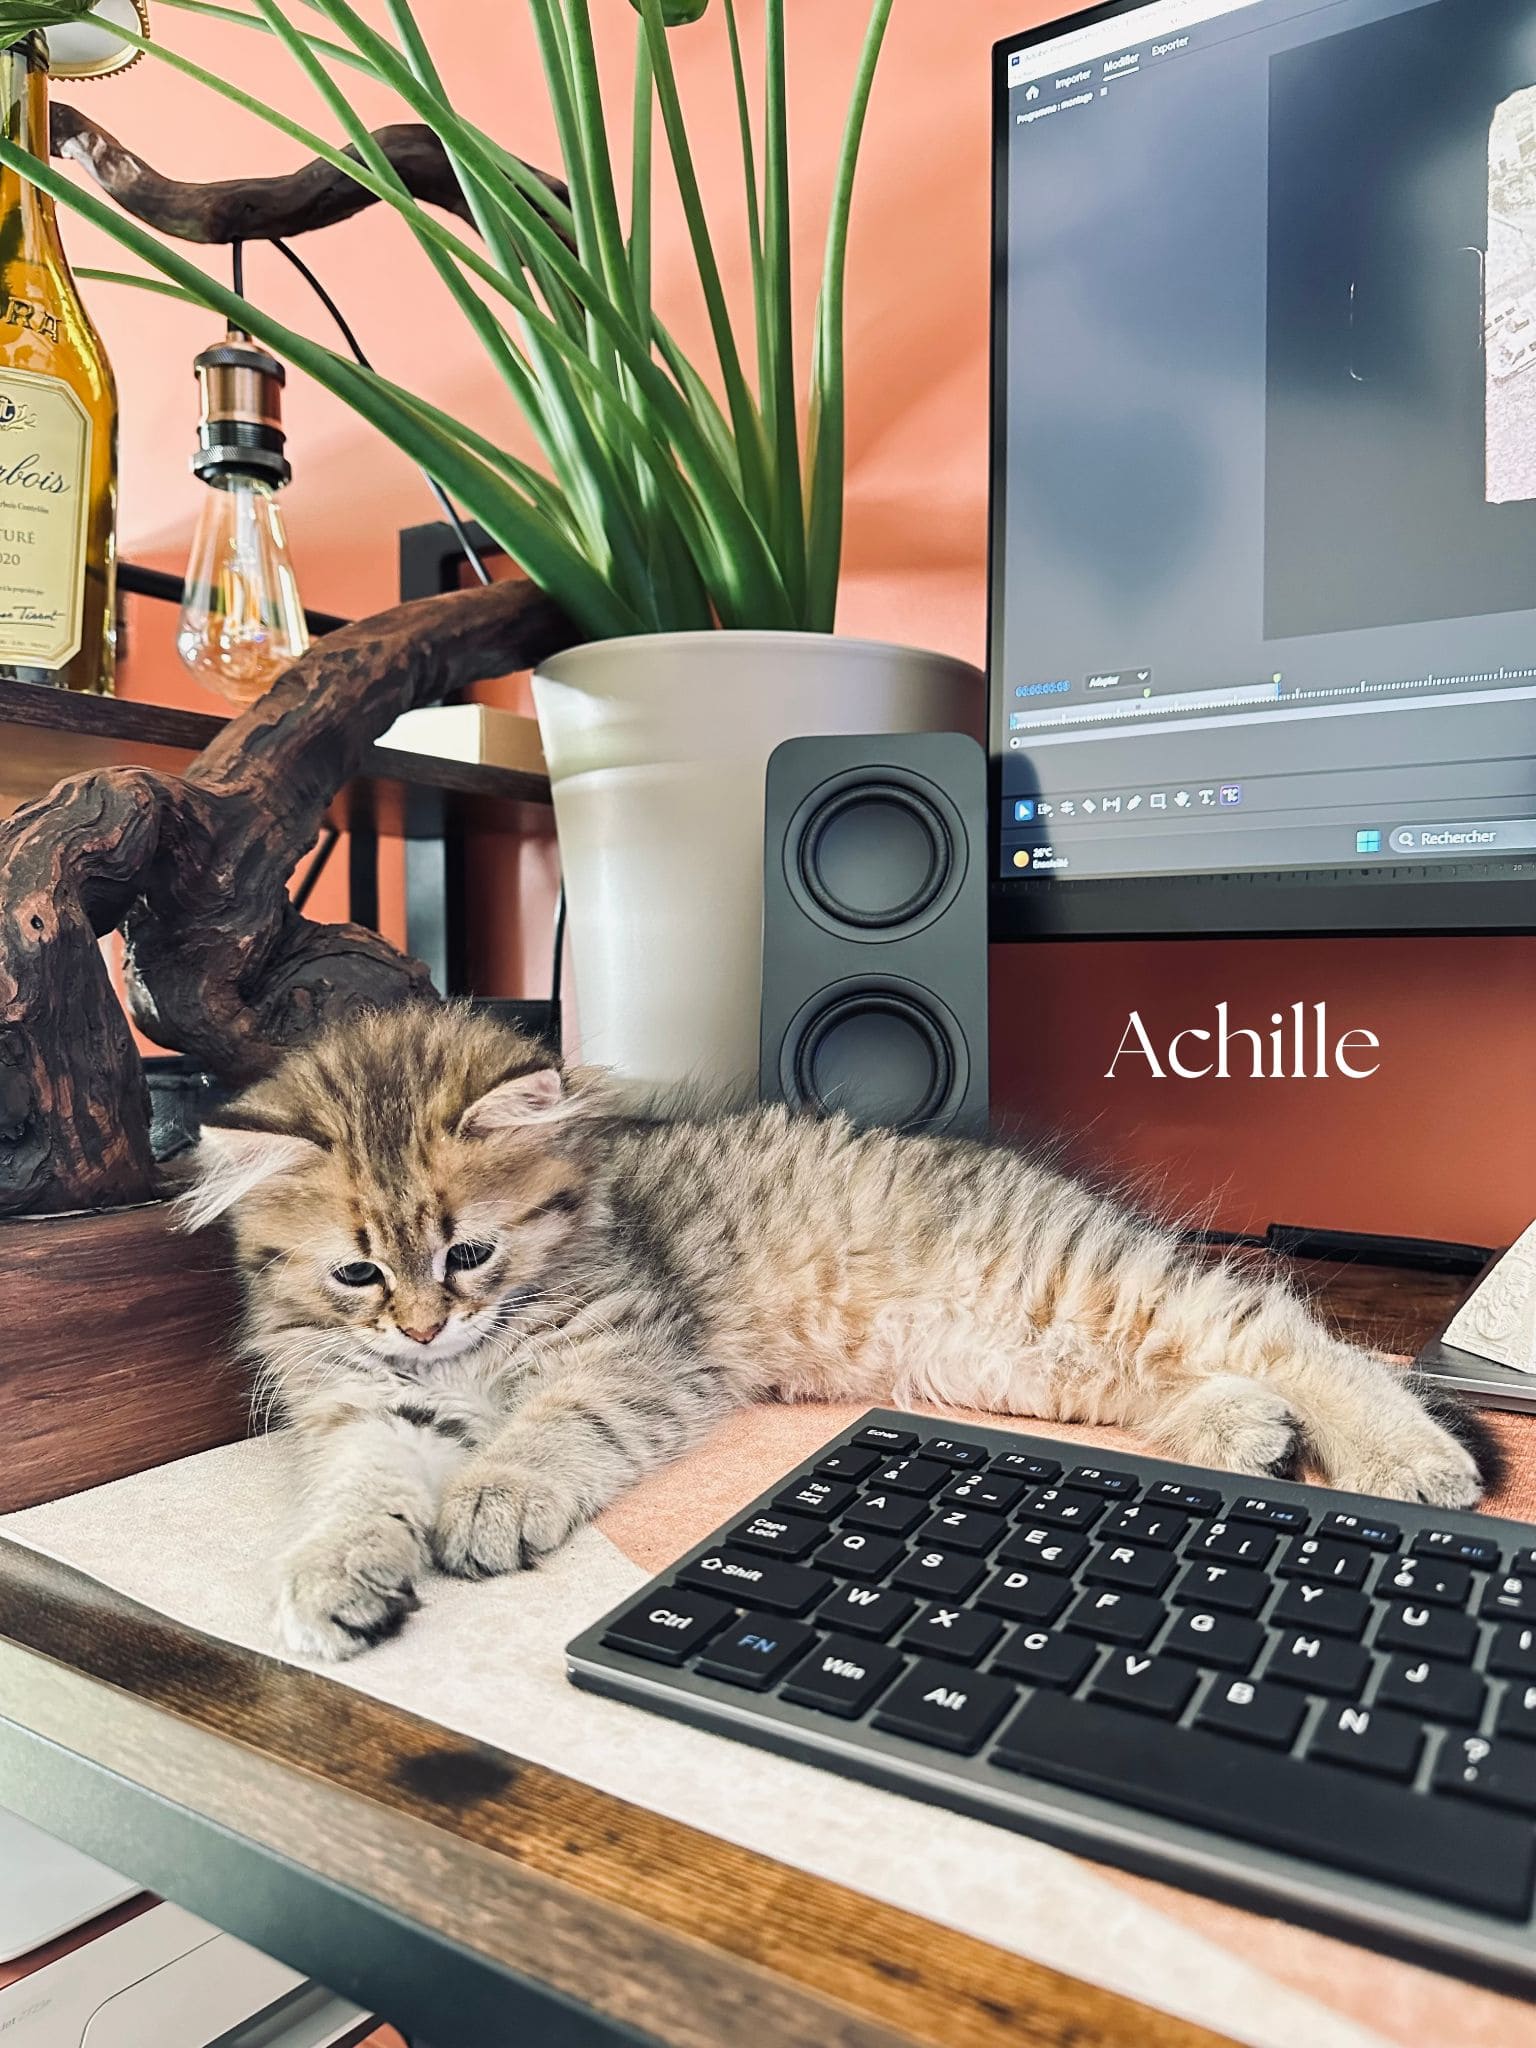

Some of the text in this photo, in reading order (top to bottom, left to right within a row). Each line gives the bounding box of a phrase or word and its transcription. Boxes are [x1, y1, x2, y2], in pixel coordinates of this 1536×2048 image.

[1055, 36, 1189, 89] Importer Modifier Exporter
[1421, 829, 1497, 847] Rechercher
[935, 1441, 953, 1450] F1
[1006, 1455, 1026, 1464] F2
[965, 1475, 983, 1486] 2
[1081, 1469, 1101, 1479] F3
[808, 1482, 831, 1494] Tab
[1042, 1490, 1058, 1500] 3
[1160, 1484, 1181, 1494] F4
[866, 1496, 887, 1509] A
[942, 1511, 967, 1526] Z
[1124, 1507, 1140, 1518] 4
[746, 1526, 779, 1539] Lock
[752, 1518, 788, 1532] Caps
[1210, 1523, 1227, 1535] 5
[843, 1535, 866, 1550] Q
[1024, 1529, 1049, 1545] E
[1429, 1532, 1453, 1544] F7
[1301, 1540, 1319, 1554] 6
[921, 1553, 944, 1568] S
[1109, 1547, 1136, 1564] R
[721, 1563, 763, 1582] Shift
[1003, 1572, 1029, 1588] D
[1206, 1566, 1227, 1582] T
[847, 1587, 881, 1606] W
[1095, 1593, 1121, 1609] F
[1300, 1585, 1324, 1603] Y
[648, 1609, 693, 1630] Ctrl
[929, 1609, 960, 1628] X
[1190, 1614, 1215, 1632] G
[1402, 1606, 1430, 1627] U
[737, 1634, 777, 1653] FN
[1023, 1633, 1049, 1650] C
[1292, 1636, 1321, 1658] H
[822, 1656, 866, 1680] Win
[1125, 1655, 1151, 1676] V
[1404, 1663, 1429, 1683] J
[923, 1687, 967, 1711] Alt
[1226, 1682, 1255, 1705] B
[1338, 1708, 1370, 1735] N
